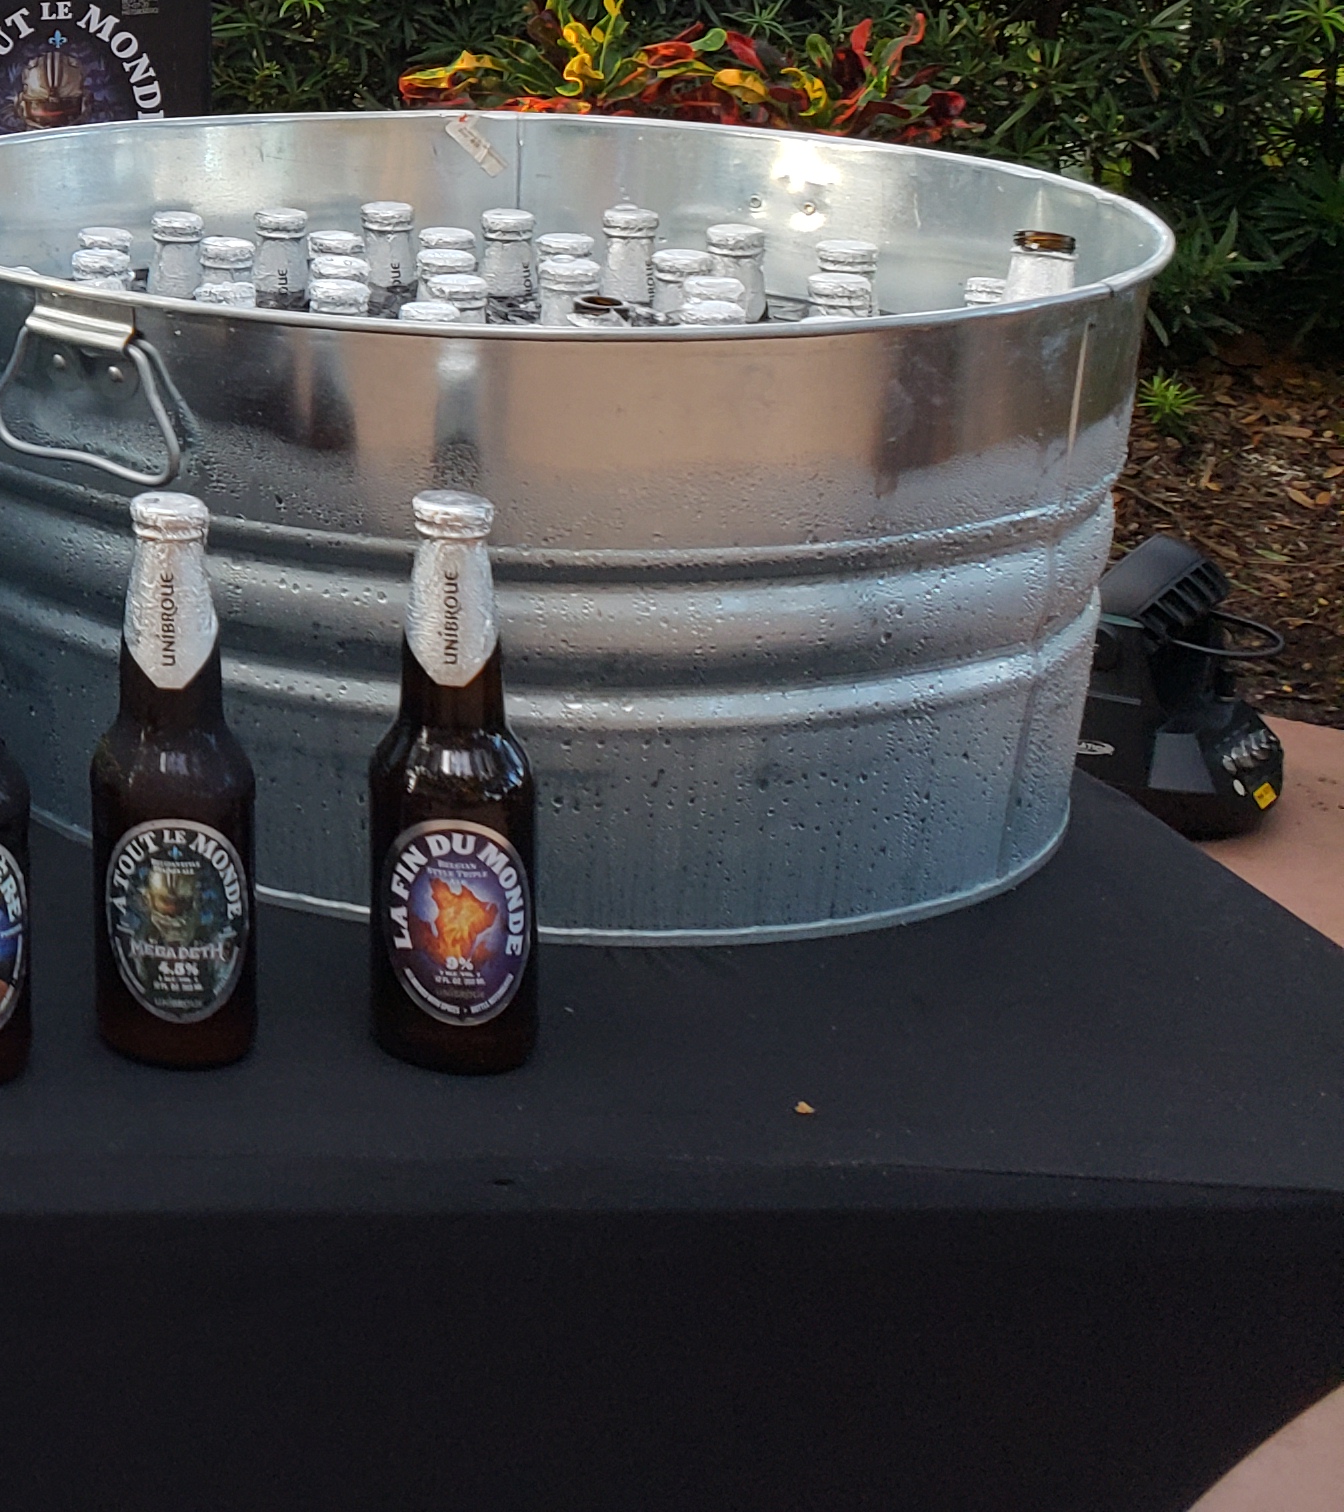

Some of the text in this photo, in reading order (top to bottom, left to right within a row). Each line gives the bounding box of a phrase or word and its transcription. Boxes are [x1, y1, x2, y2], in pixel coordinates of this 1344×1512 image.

[40, 1, 72, 21] LE
[156, 572, 177, 667] UNIBROUE
[438, 570, 460, 665] UNIBROUE
[113, 831, 160, 892] TOUT
[163, 830, 186, 843] LE
[189, 833, 243, 920] MONDE
[390, 833, 525, 956] LA FIN DU MONDE
[455, 870, 488, 878] TRIPLE
[129, 939, 226, 962] MEGADETH
